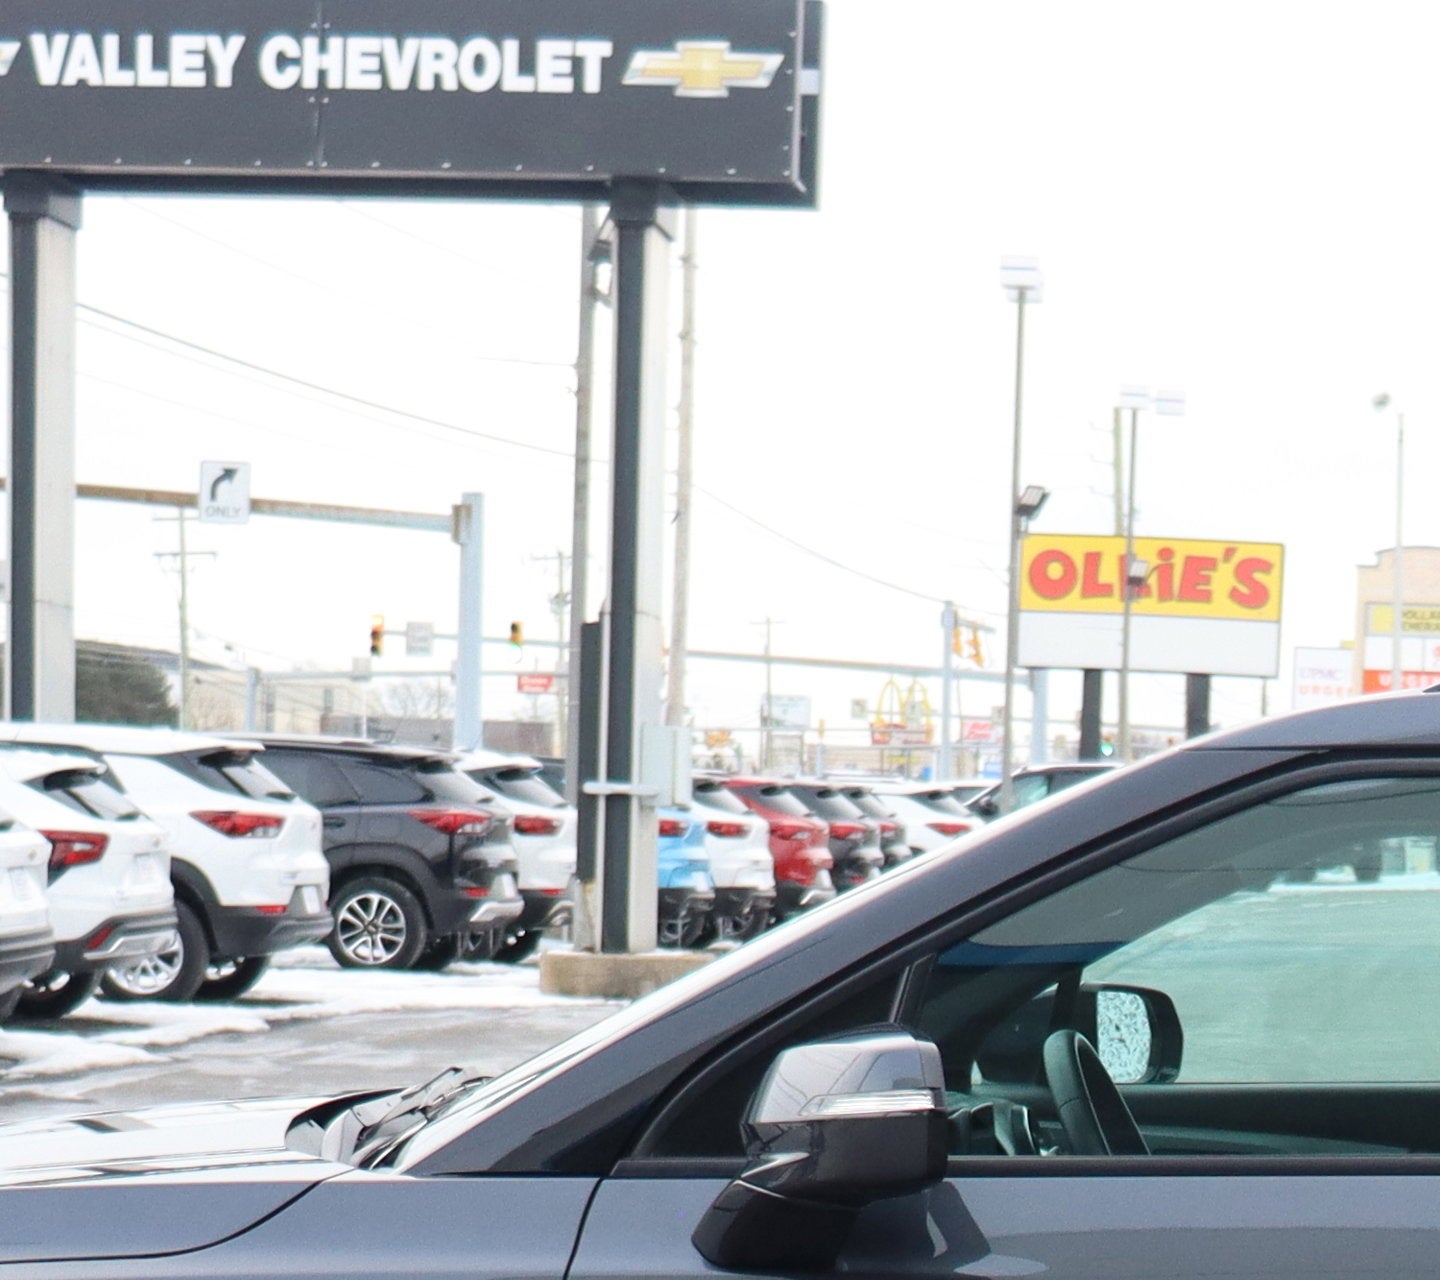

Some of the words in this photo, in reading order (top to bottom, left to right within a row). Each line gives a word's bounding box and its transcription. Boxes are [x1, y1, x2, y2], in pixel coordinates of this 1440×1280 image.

[29, 34, 246, 89] VALLEY
[258, 38, 613, 94] CHEVROLET
[205, 506, 242, 519] ONLY
